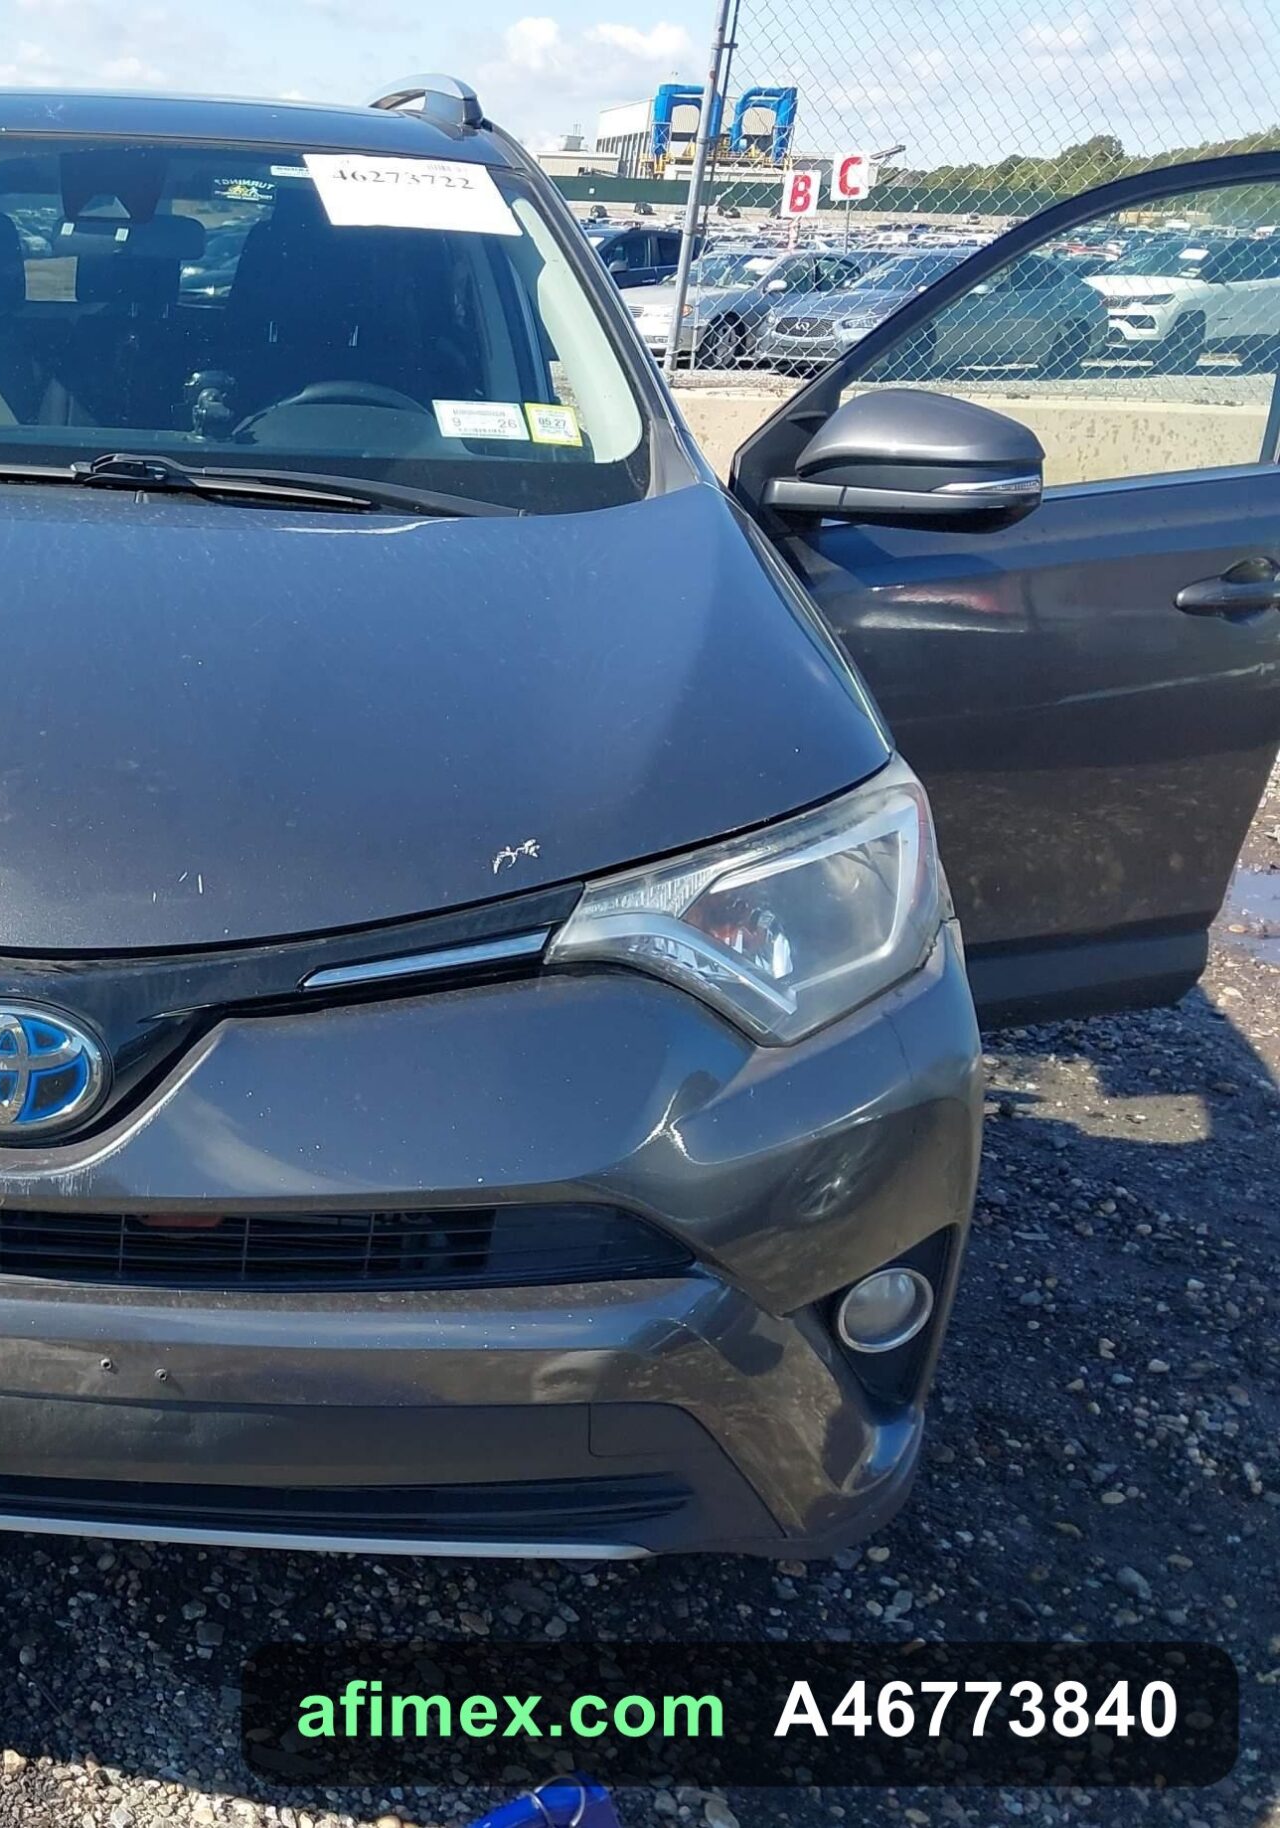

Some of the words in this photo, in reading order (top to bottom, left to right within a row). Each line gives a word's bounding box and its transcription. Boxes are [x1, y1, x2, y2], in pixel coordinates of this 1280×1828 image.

[332, 168, 476, 190] 46273722
[839, 156, 862, 196] C
[789, 174, 812, 213] B
[497, 418, 518, 430] 26
